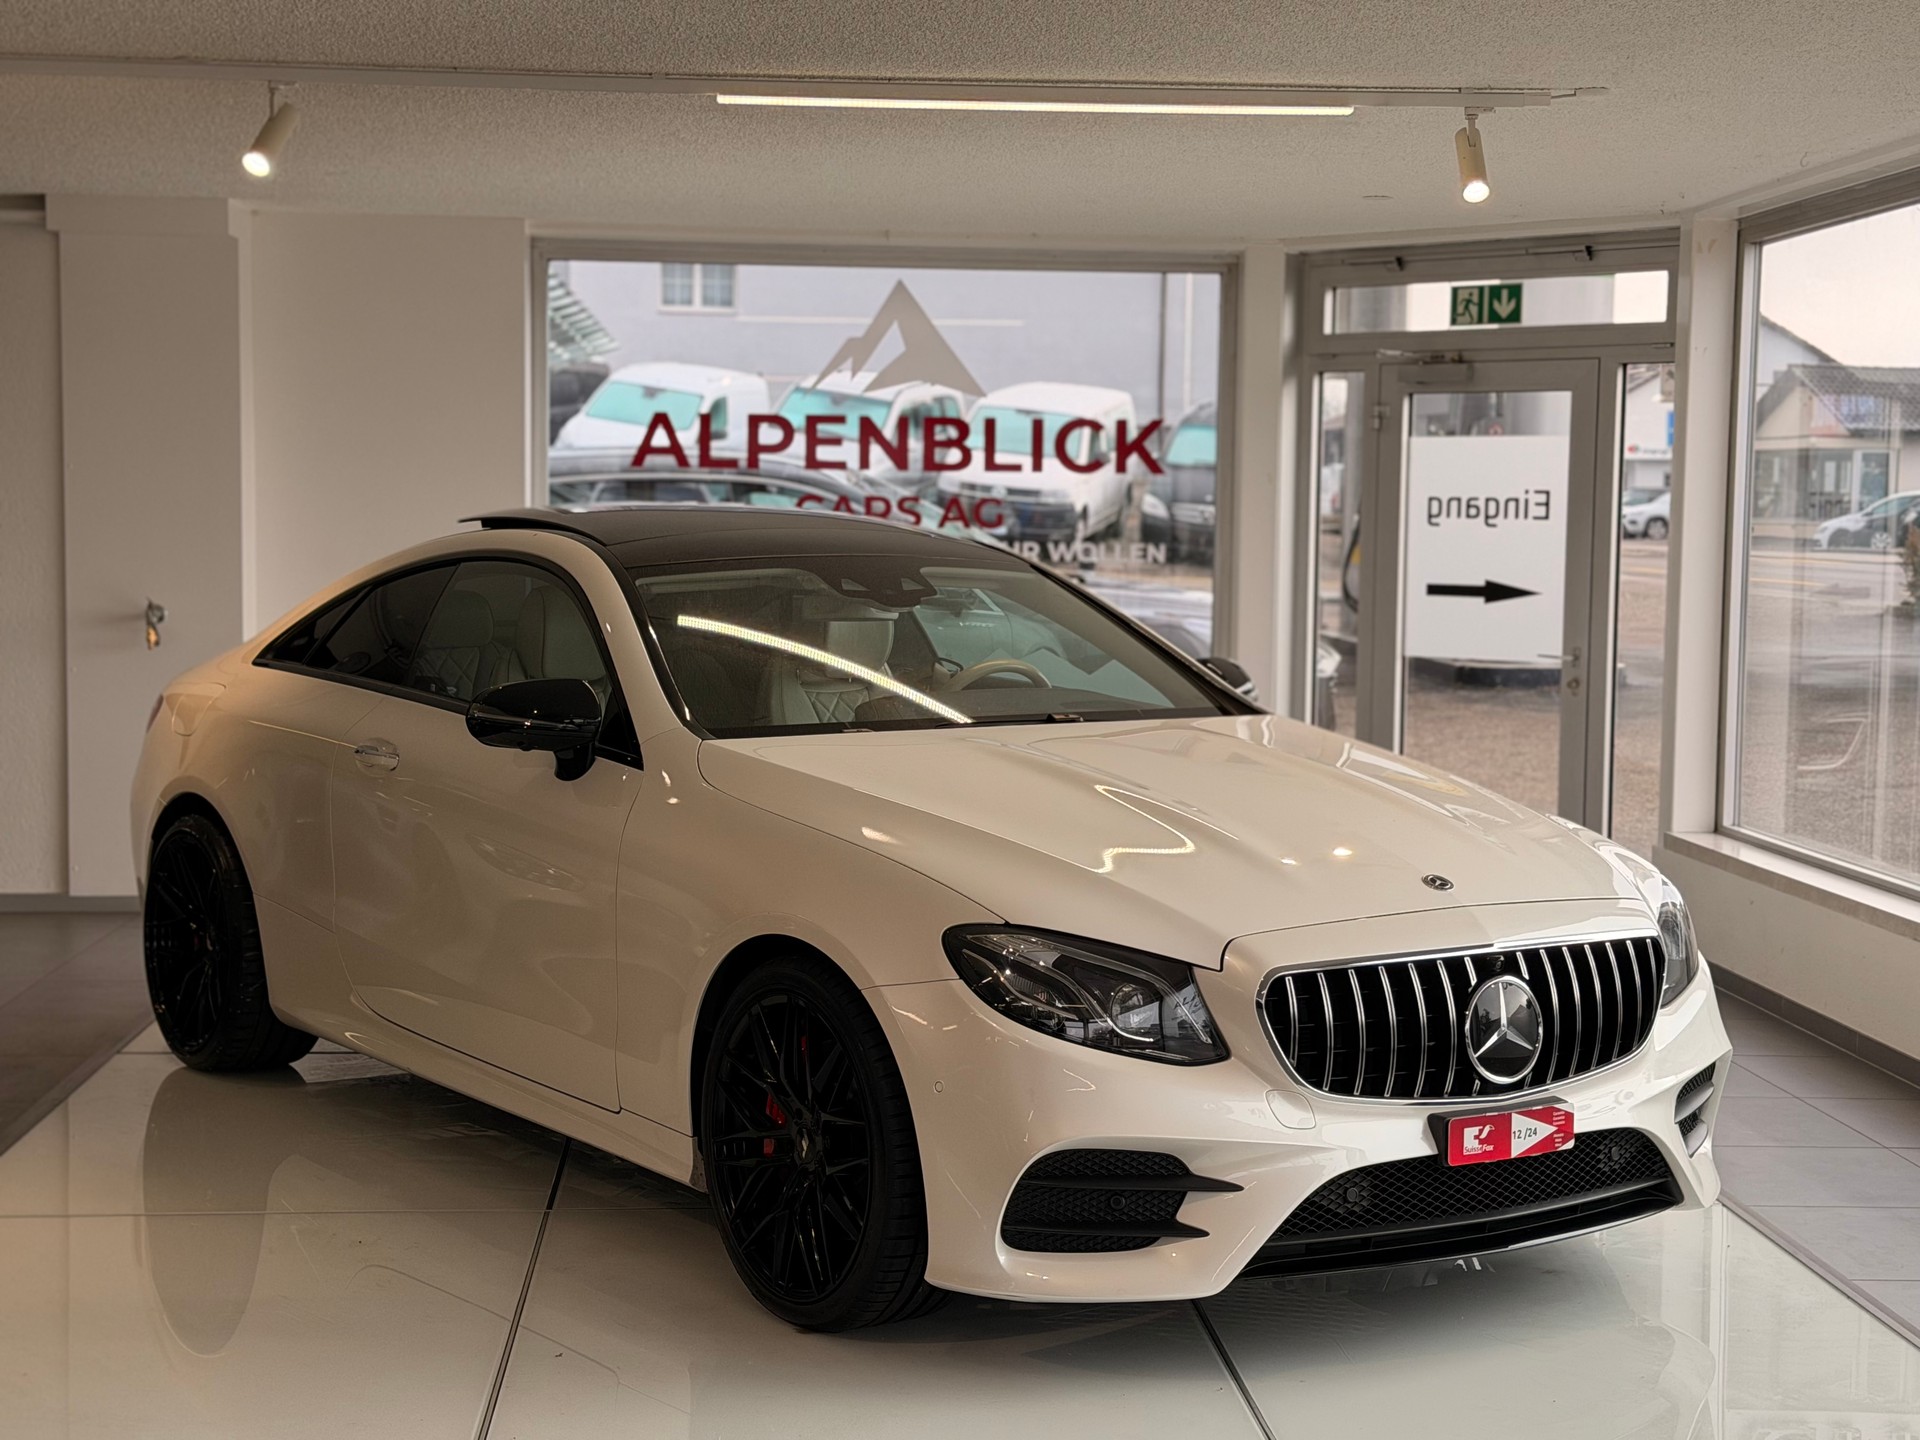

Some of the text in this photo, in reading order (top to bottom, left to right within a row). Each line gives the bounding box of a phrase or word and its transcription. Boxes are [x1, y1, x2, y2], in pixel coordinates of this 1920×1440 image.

[631, 412, 1165, 474] ALPENBLICK
[938, 496, 1004, 529] AG
[1046, 541, 1168, 563] WOLLEN
